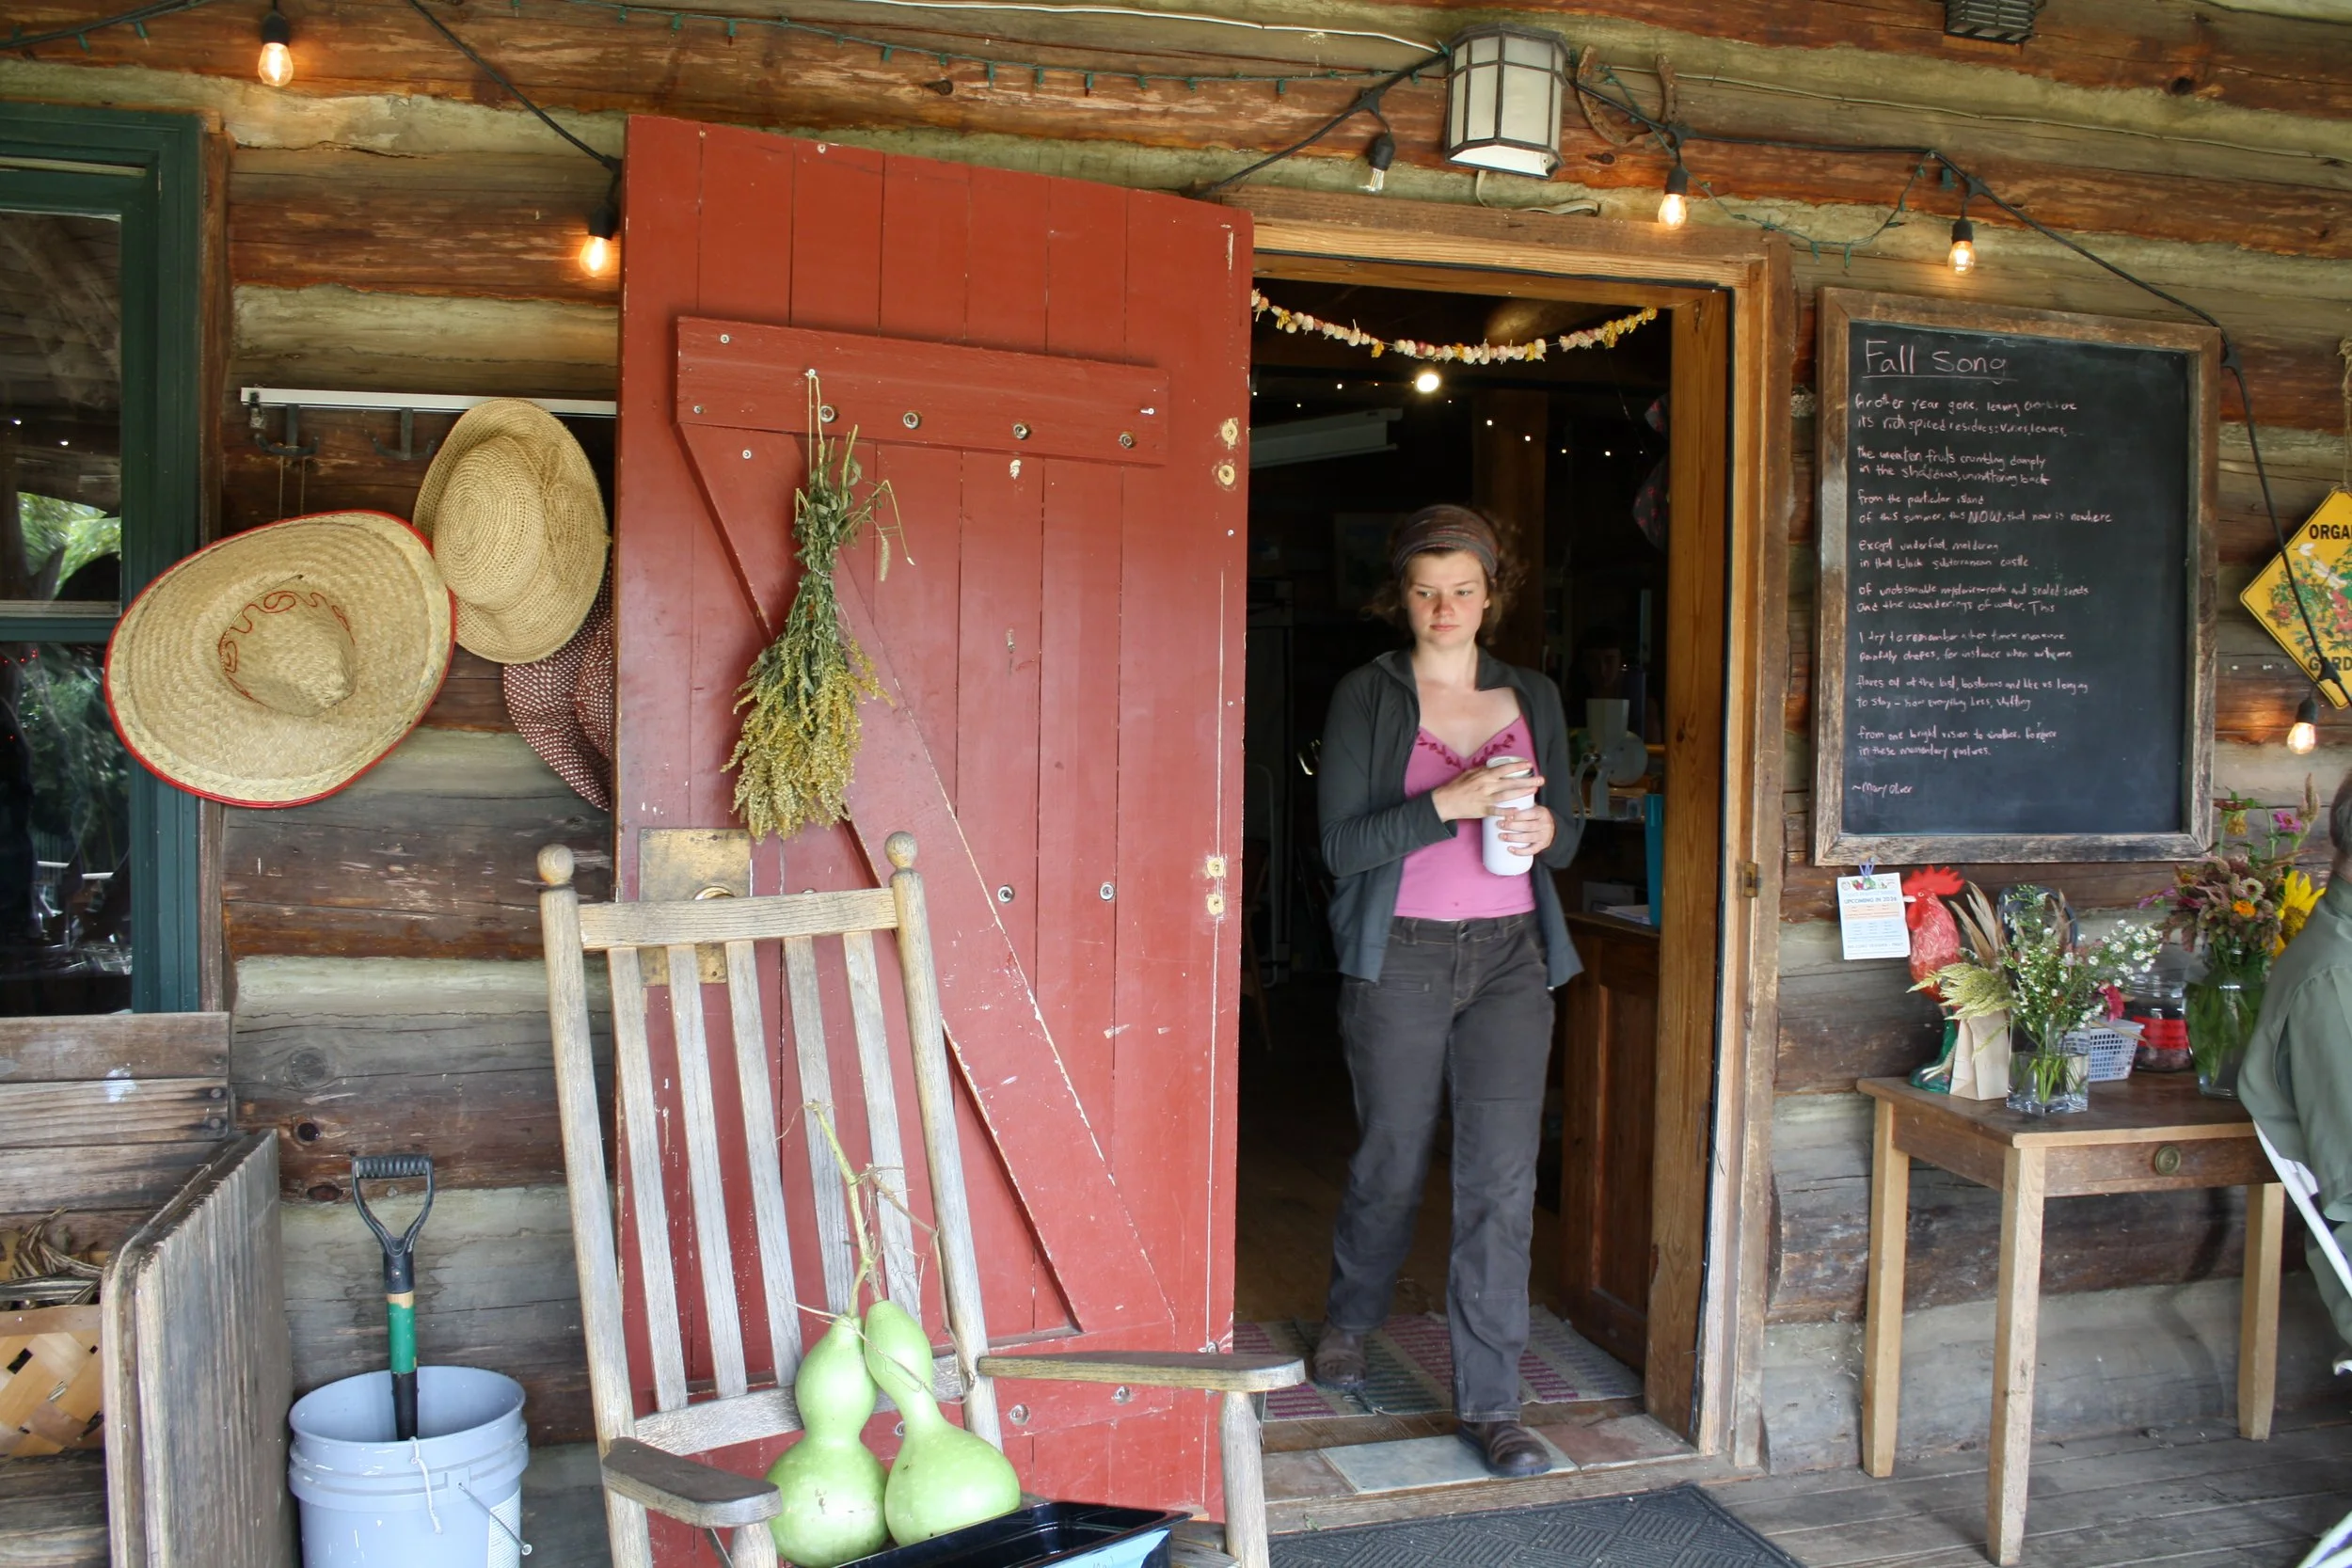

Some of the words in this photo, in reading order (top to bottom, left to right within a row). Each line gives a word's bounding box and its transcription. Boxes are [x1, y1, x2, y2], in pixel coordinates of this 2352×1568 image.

[1866, 340, 1914, 373] Fall
[1931, 351, 2007, 385] Song
[1857, 445, 1875, 459] the
[1859, 465, 1870, 474] in
[1875, 464, 1895, 476] the
[1857, 489, 1883, 505] from
[1887, 493, 1901, 503] the
[1858, 512, 1871, 524] of
[2071, 510, 2113, 523] nowhere
[2309, 524, 2352, 540] ORGA
[1859, 559, 1870, 568] in
[1858, 582, 1872, 595] of
[1856, 602, 1880, 613] and
[1882, 599, 1904, 610] the
[1978, 599, 1992, 611] of
[2027, 600, 2055, 616] This
[1867, 631, 1885, 645] try
[1855, 695, 1868, 707] to
[1857, 725, 1885, 740] from
[1888, 731, 1903, 741] one
[1973, 728, 1983, 740] to
